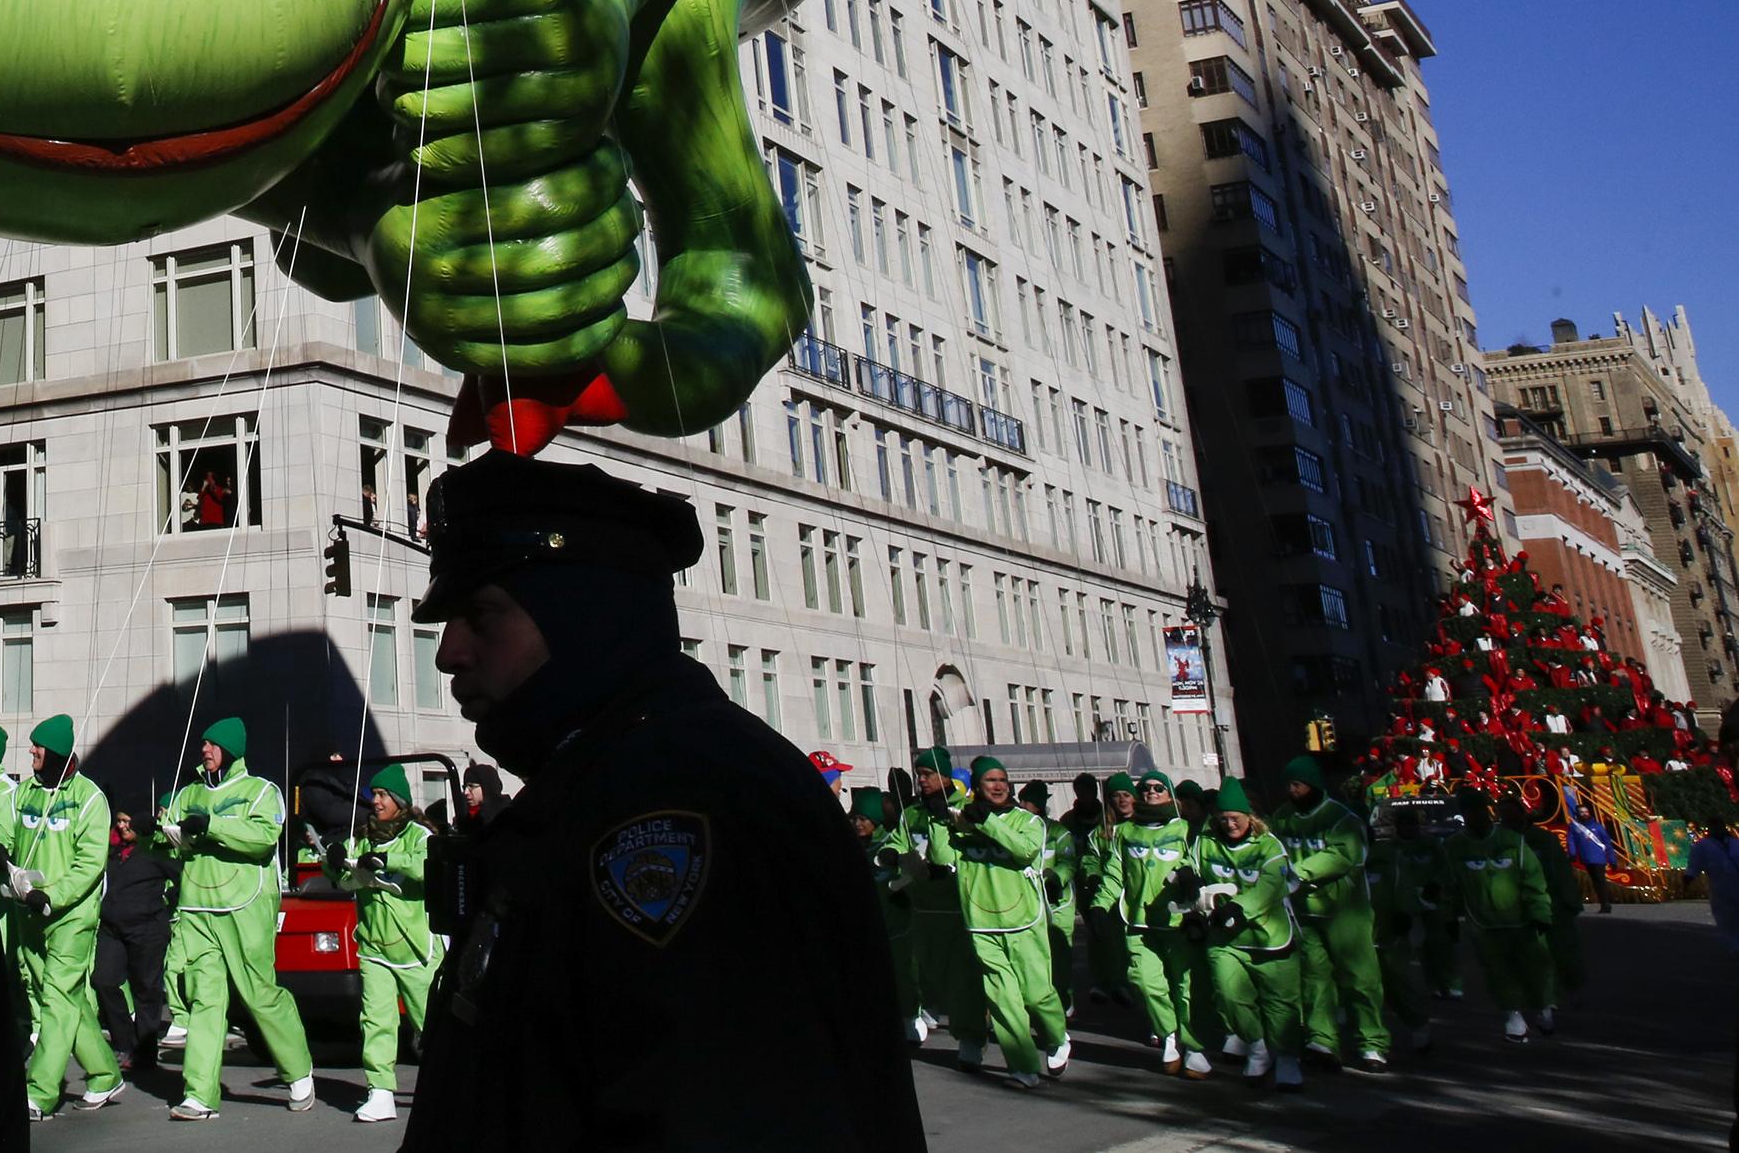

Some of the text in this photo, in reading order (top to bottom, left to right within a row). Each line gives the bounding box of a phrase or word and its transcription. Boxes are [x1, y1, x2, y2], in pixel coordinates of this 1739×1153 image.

[599, 831, 696, 867] DEPARTMENT
[617, 819, 673, 843] POLICE
[600, 879, 643, 924] CITY OF
[664, 854, 703, 925] NEW YORK
